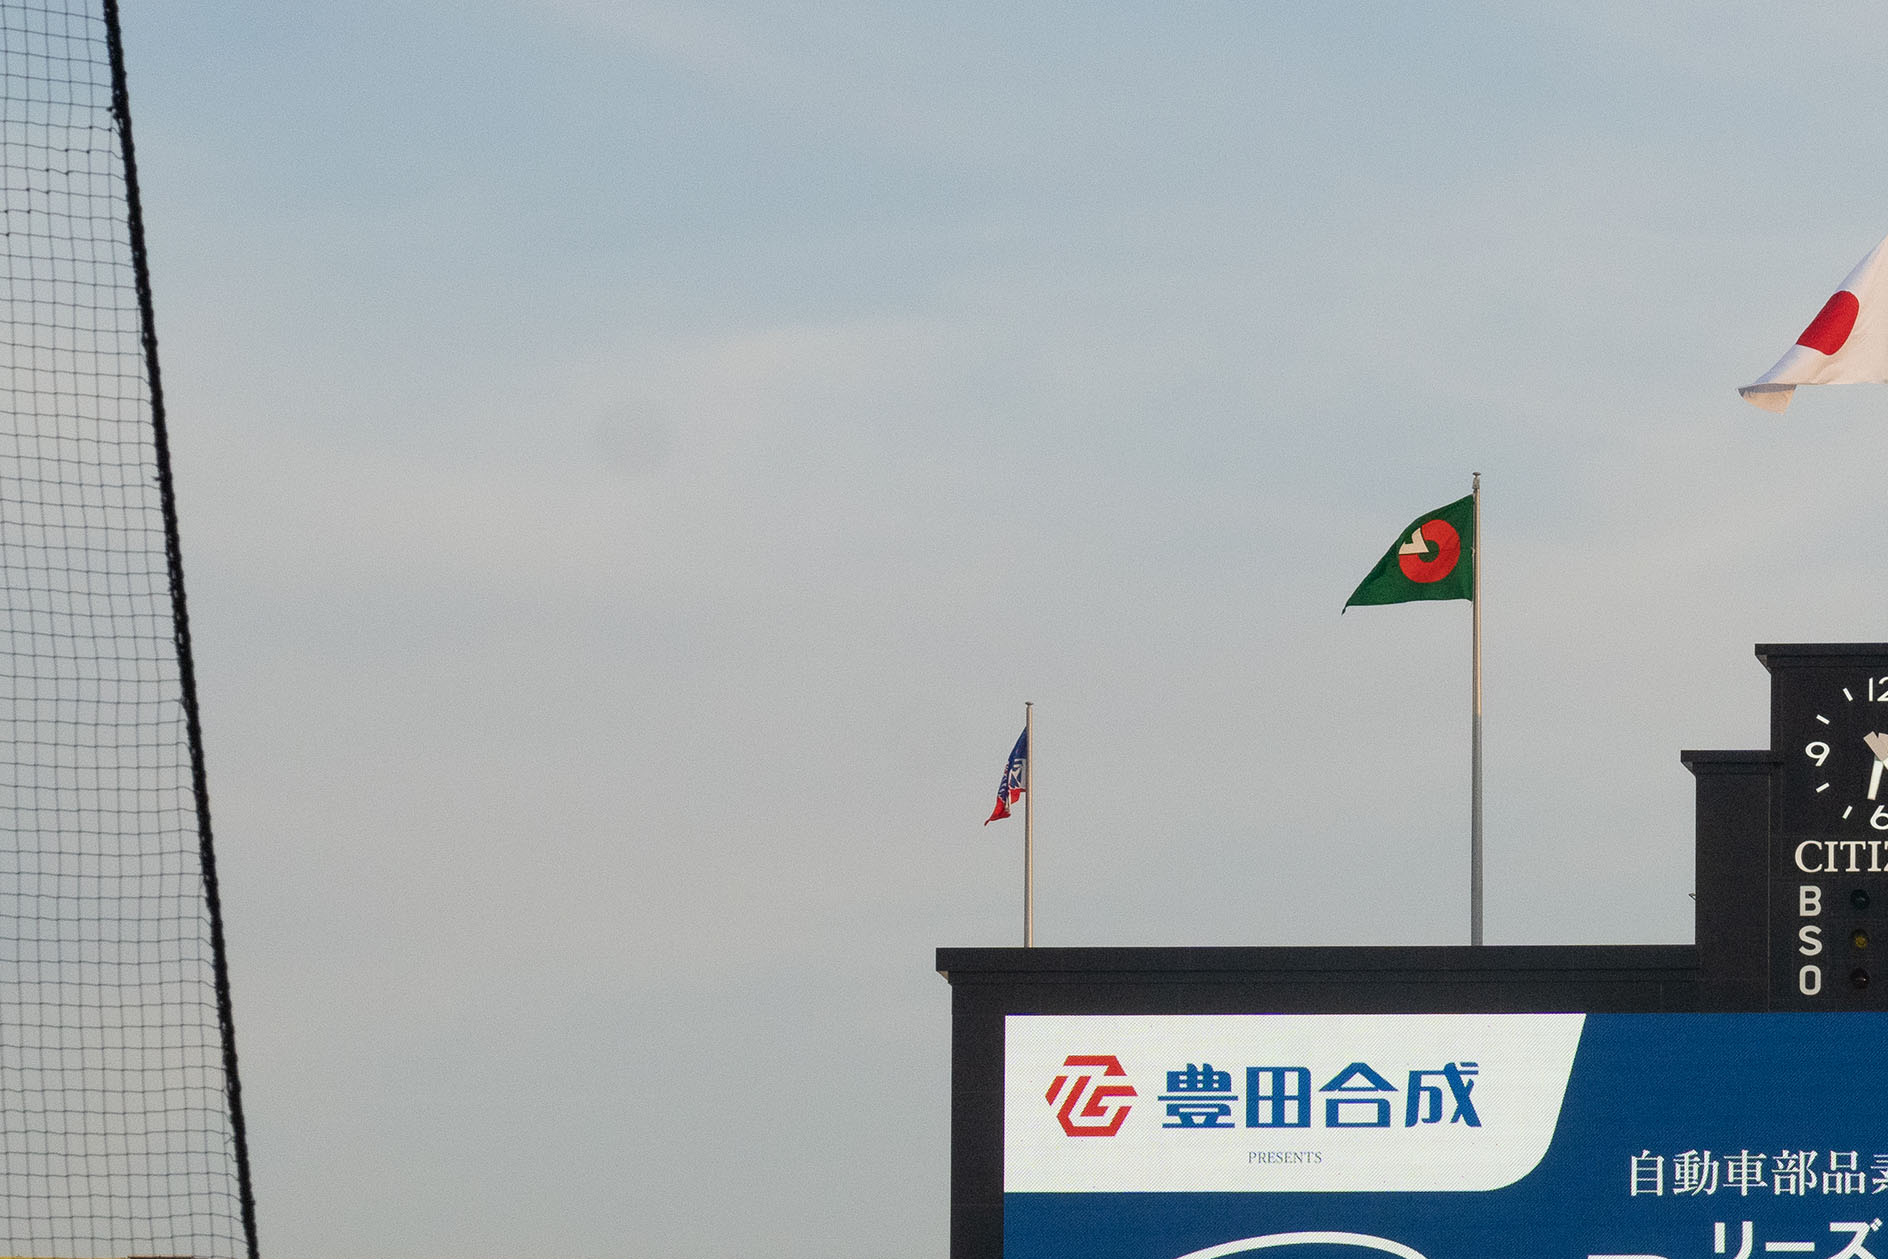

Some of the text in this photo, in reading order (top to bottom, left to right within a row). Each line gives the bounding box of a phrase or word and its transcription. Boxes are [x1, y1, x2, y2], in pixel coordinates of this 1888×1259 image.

[1805, 741, 1830, 767] 9
[1799, 885, 1822, 917] B
[1798, 925, 1822, 957] S
[1157, 1060, 1482, 1129] 豊田合成
[1247, 1150, 1323, 1165] PRESENTS
